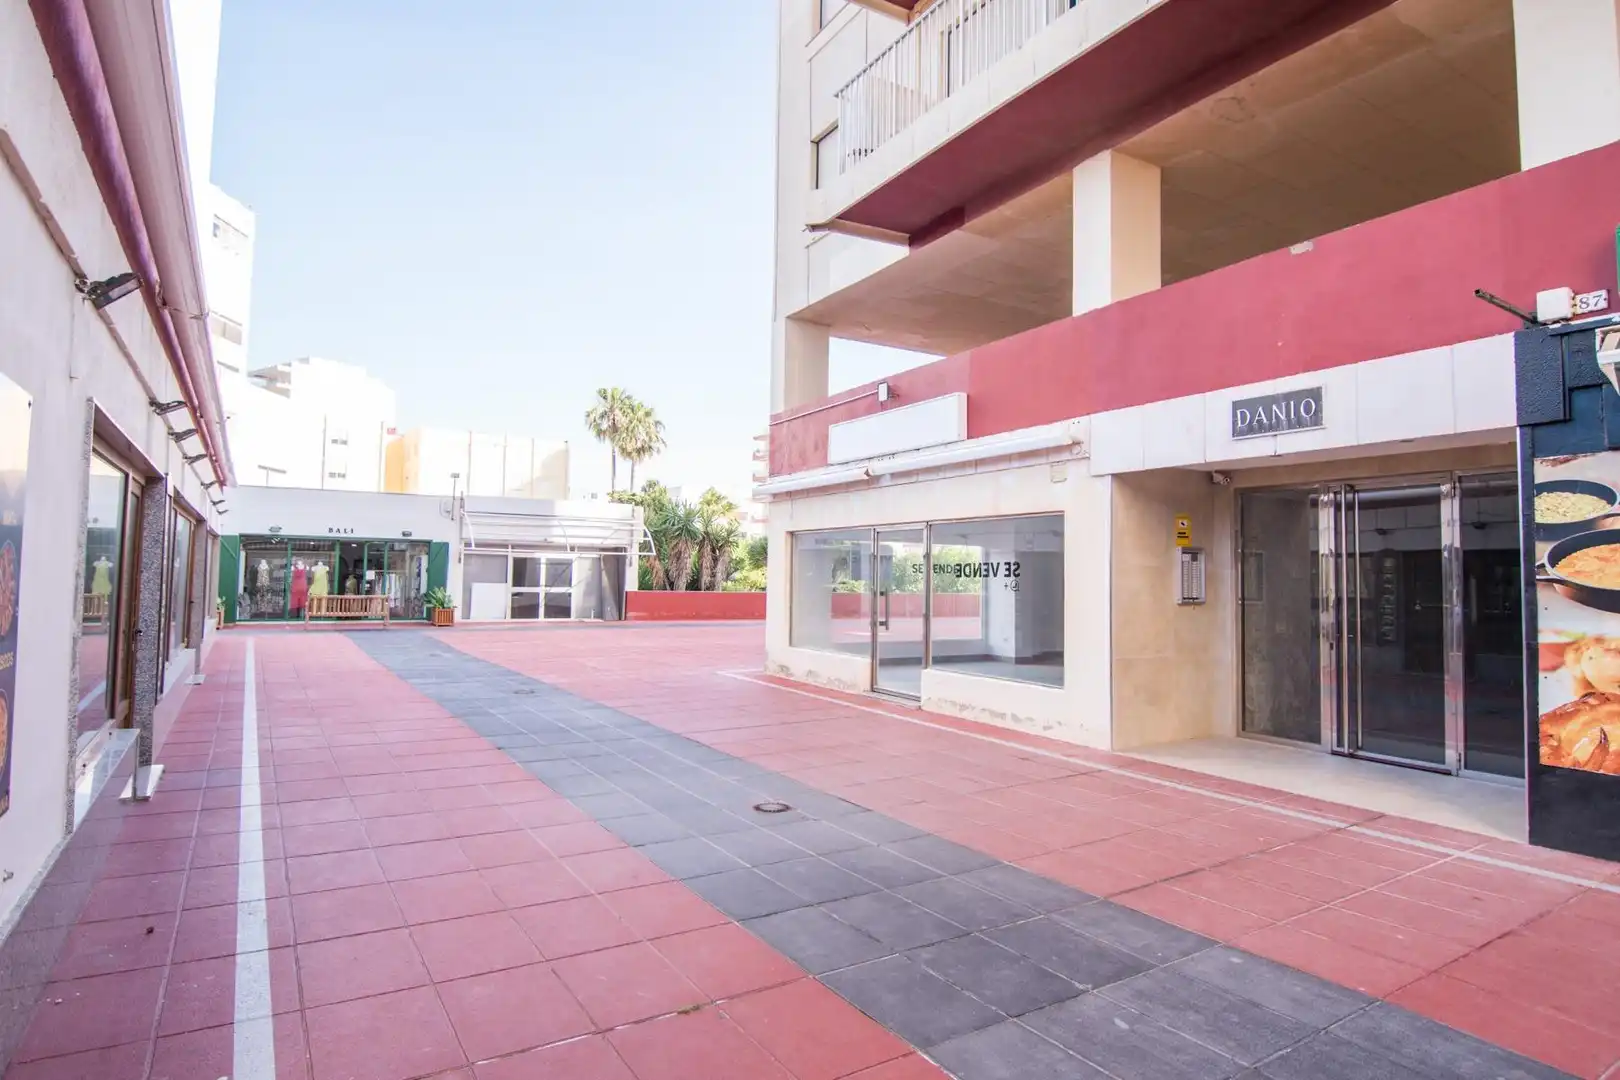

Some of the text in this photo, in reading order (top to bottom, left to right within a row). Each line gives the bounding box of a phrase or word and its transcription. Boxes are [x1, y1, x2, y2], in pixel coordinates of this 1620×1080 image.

[1579, 294, 1603, 309] 87
[1236, 398, 1316, 428] DANIO
[933, 563, 959, 575] ENDE
